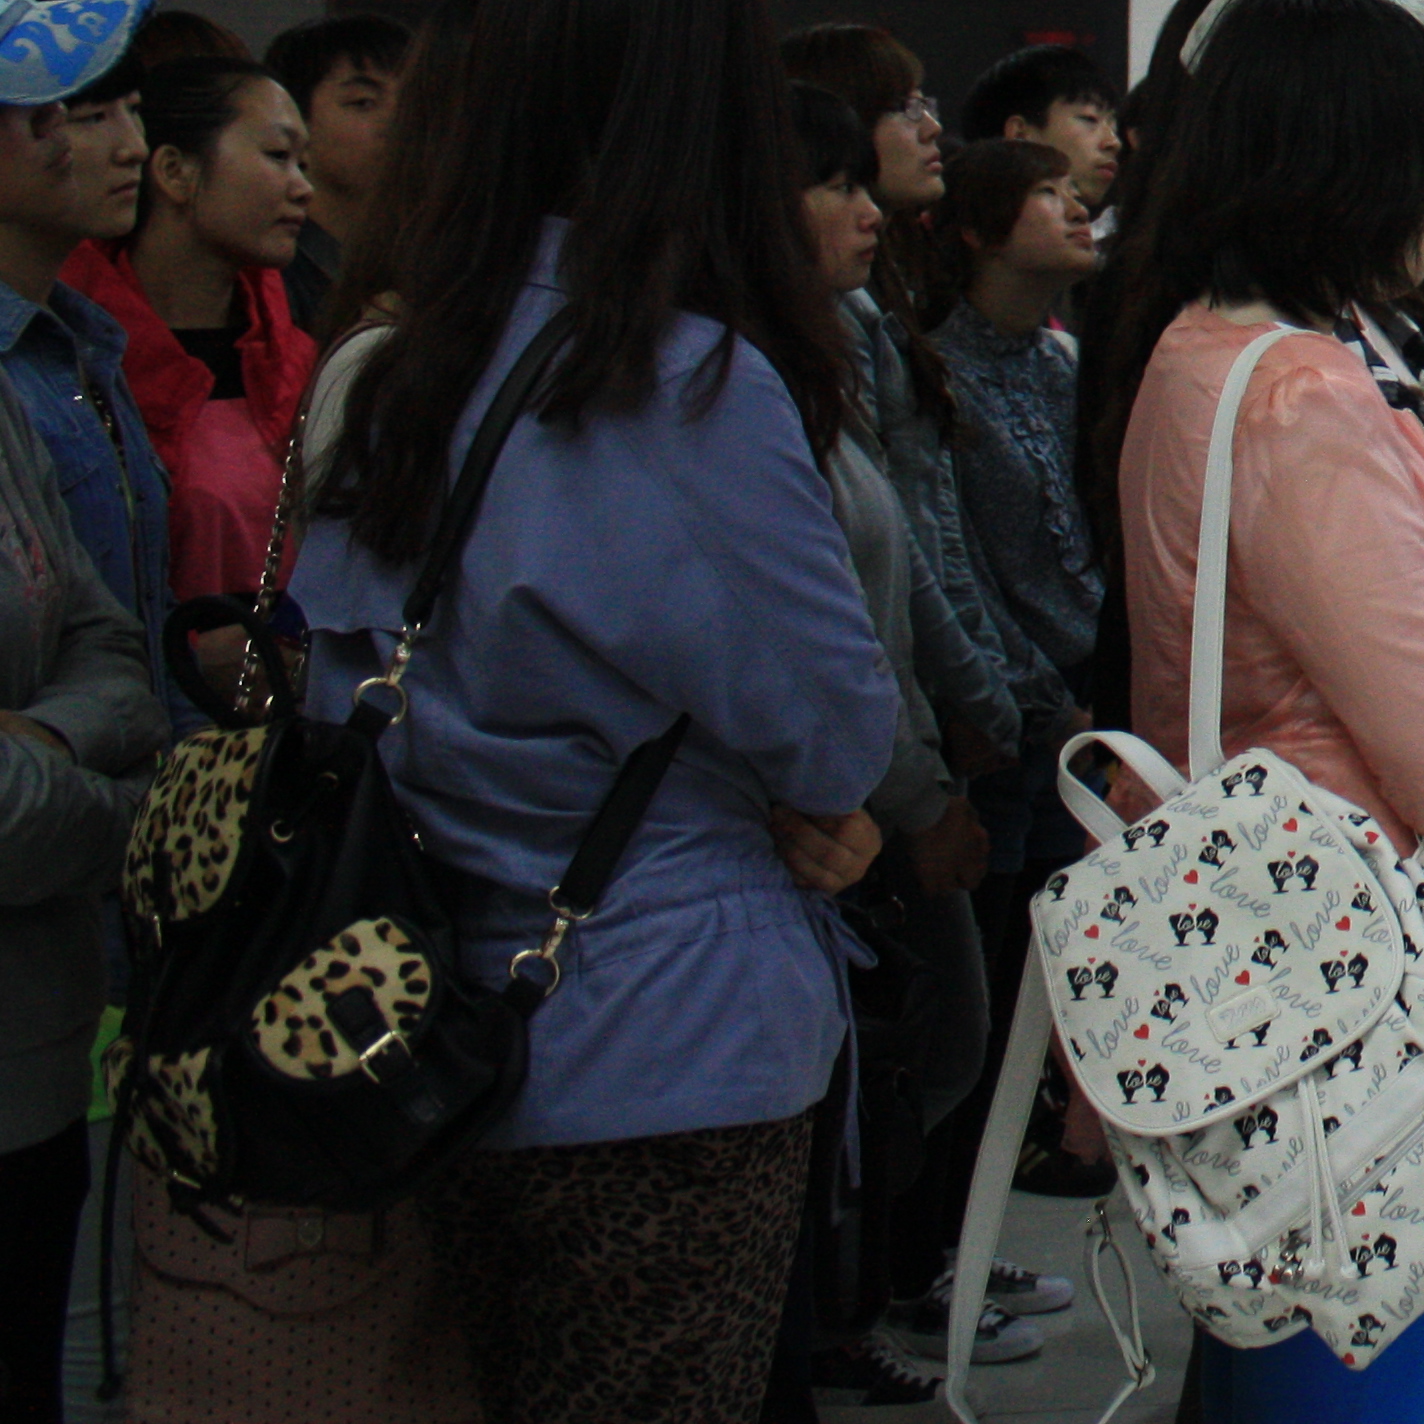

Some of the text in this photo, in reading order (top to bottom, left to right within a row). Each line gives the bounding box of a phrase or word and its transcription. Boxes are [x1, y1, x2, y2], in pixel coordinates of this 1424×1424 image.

[1237, 794, 1289, 852] love
[1138, 843, 1188, 904] love
[1209, 866, 1272, 919] love
[1042, 899, 1091, 957] love
[1110, 920, 1173, 971] love
[1289, 889, 1341, 951] love
[1190, 944, 1241, 1005] love
[1268, 966, 1322, 1018] love
[1086, 996, 1140, 1060] love
[1161, 1020, 1222, 1074] love
